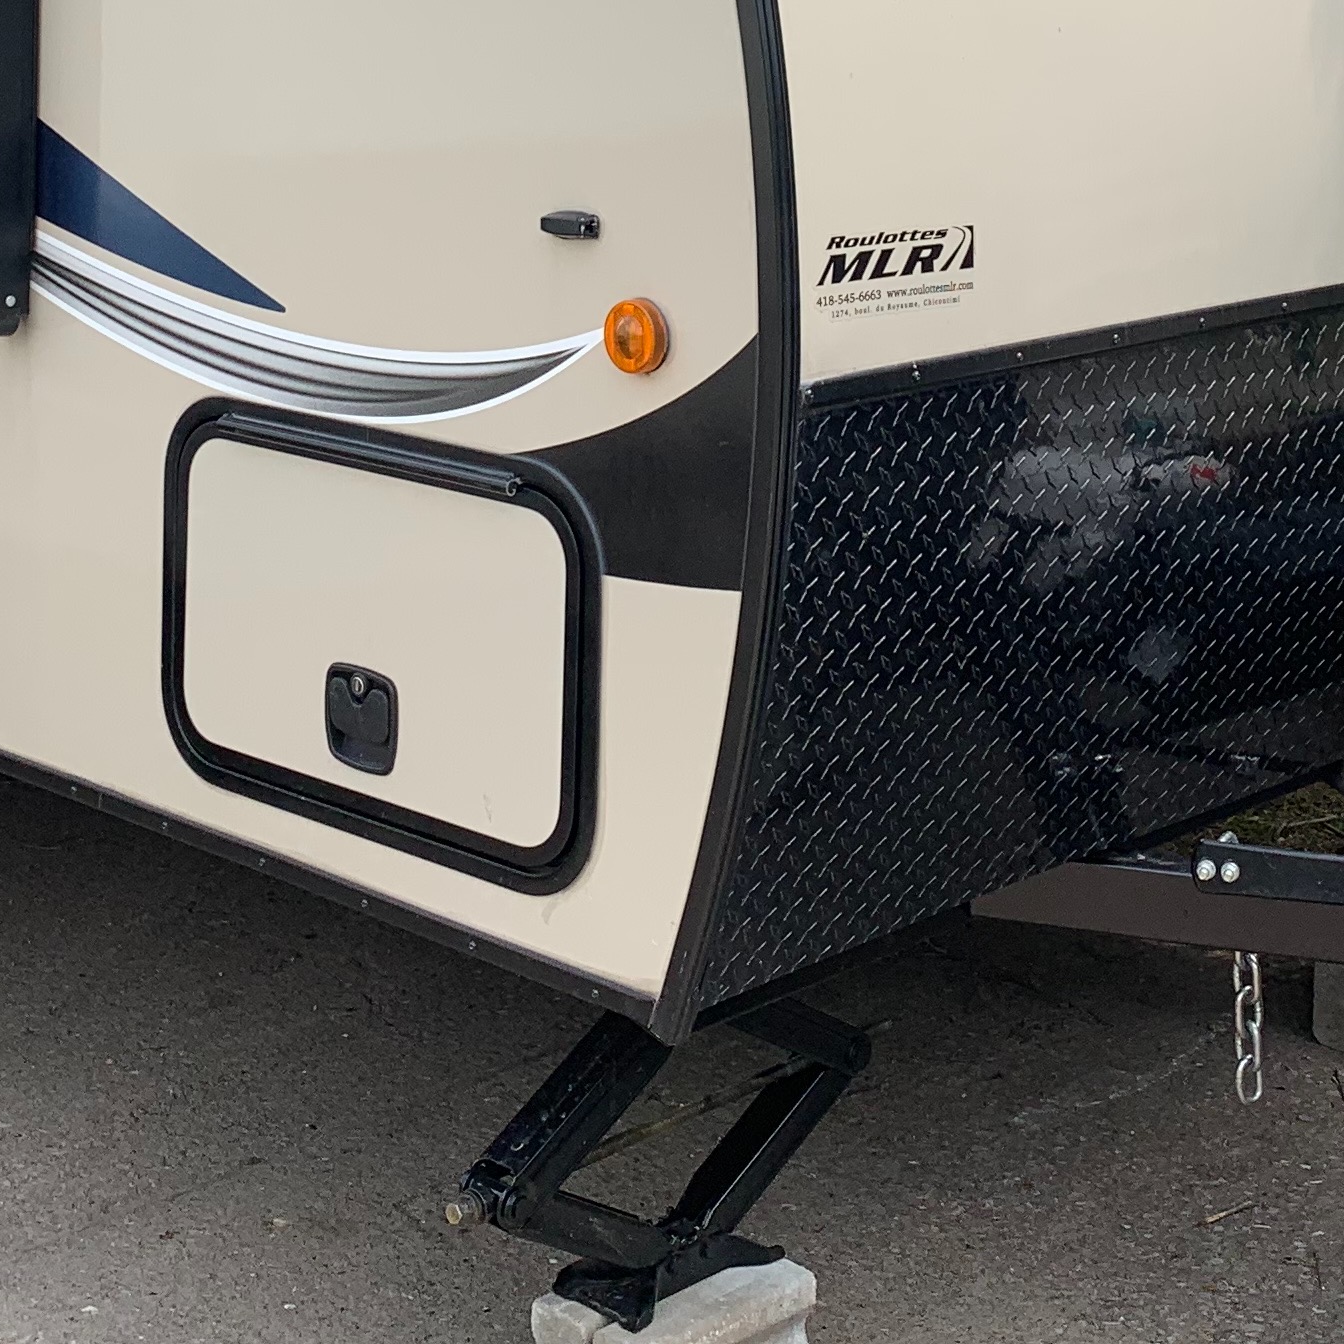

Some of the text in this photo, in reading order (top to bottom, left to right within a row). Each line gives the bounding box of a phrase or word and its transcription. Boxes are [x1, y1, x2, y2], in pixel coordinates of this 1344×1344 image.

[825, 228, 949, 250] Roulottes
[815, 243, 945, 287] MLR
[816, 289, 882, 308] 418-545-6663
